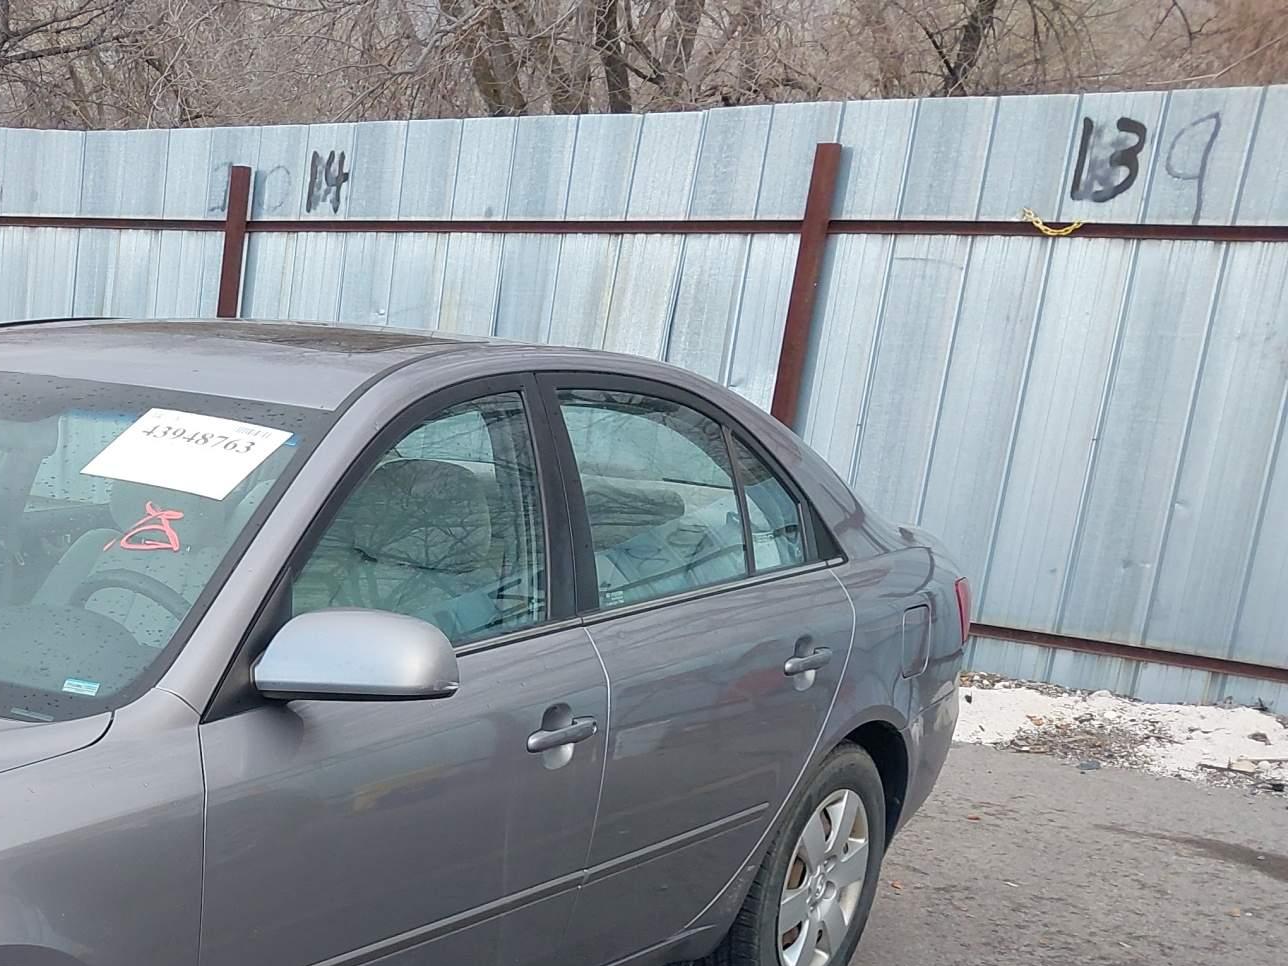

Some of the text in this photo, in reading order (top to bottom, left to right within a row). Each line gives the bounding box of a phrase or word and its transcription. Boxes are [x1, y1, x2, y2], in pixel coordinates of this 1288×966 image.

[305, 150, 350, 214] 14
[1070, 116, 1148, 204] 13
[140, 423, 256, 454] 43948763
